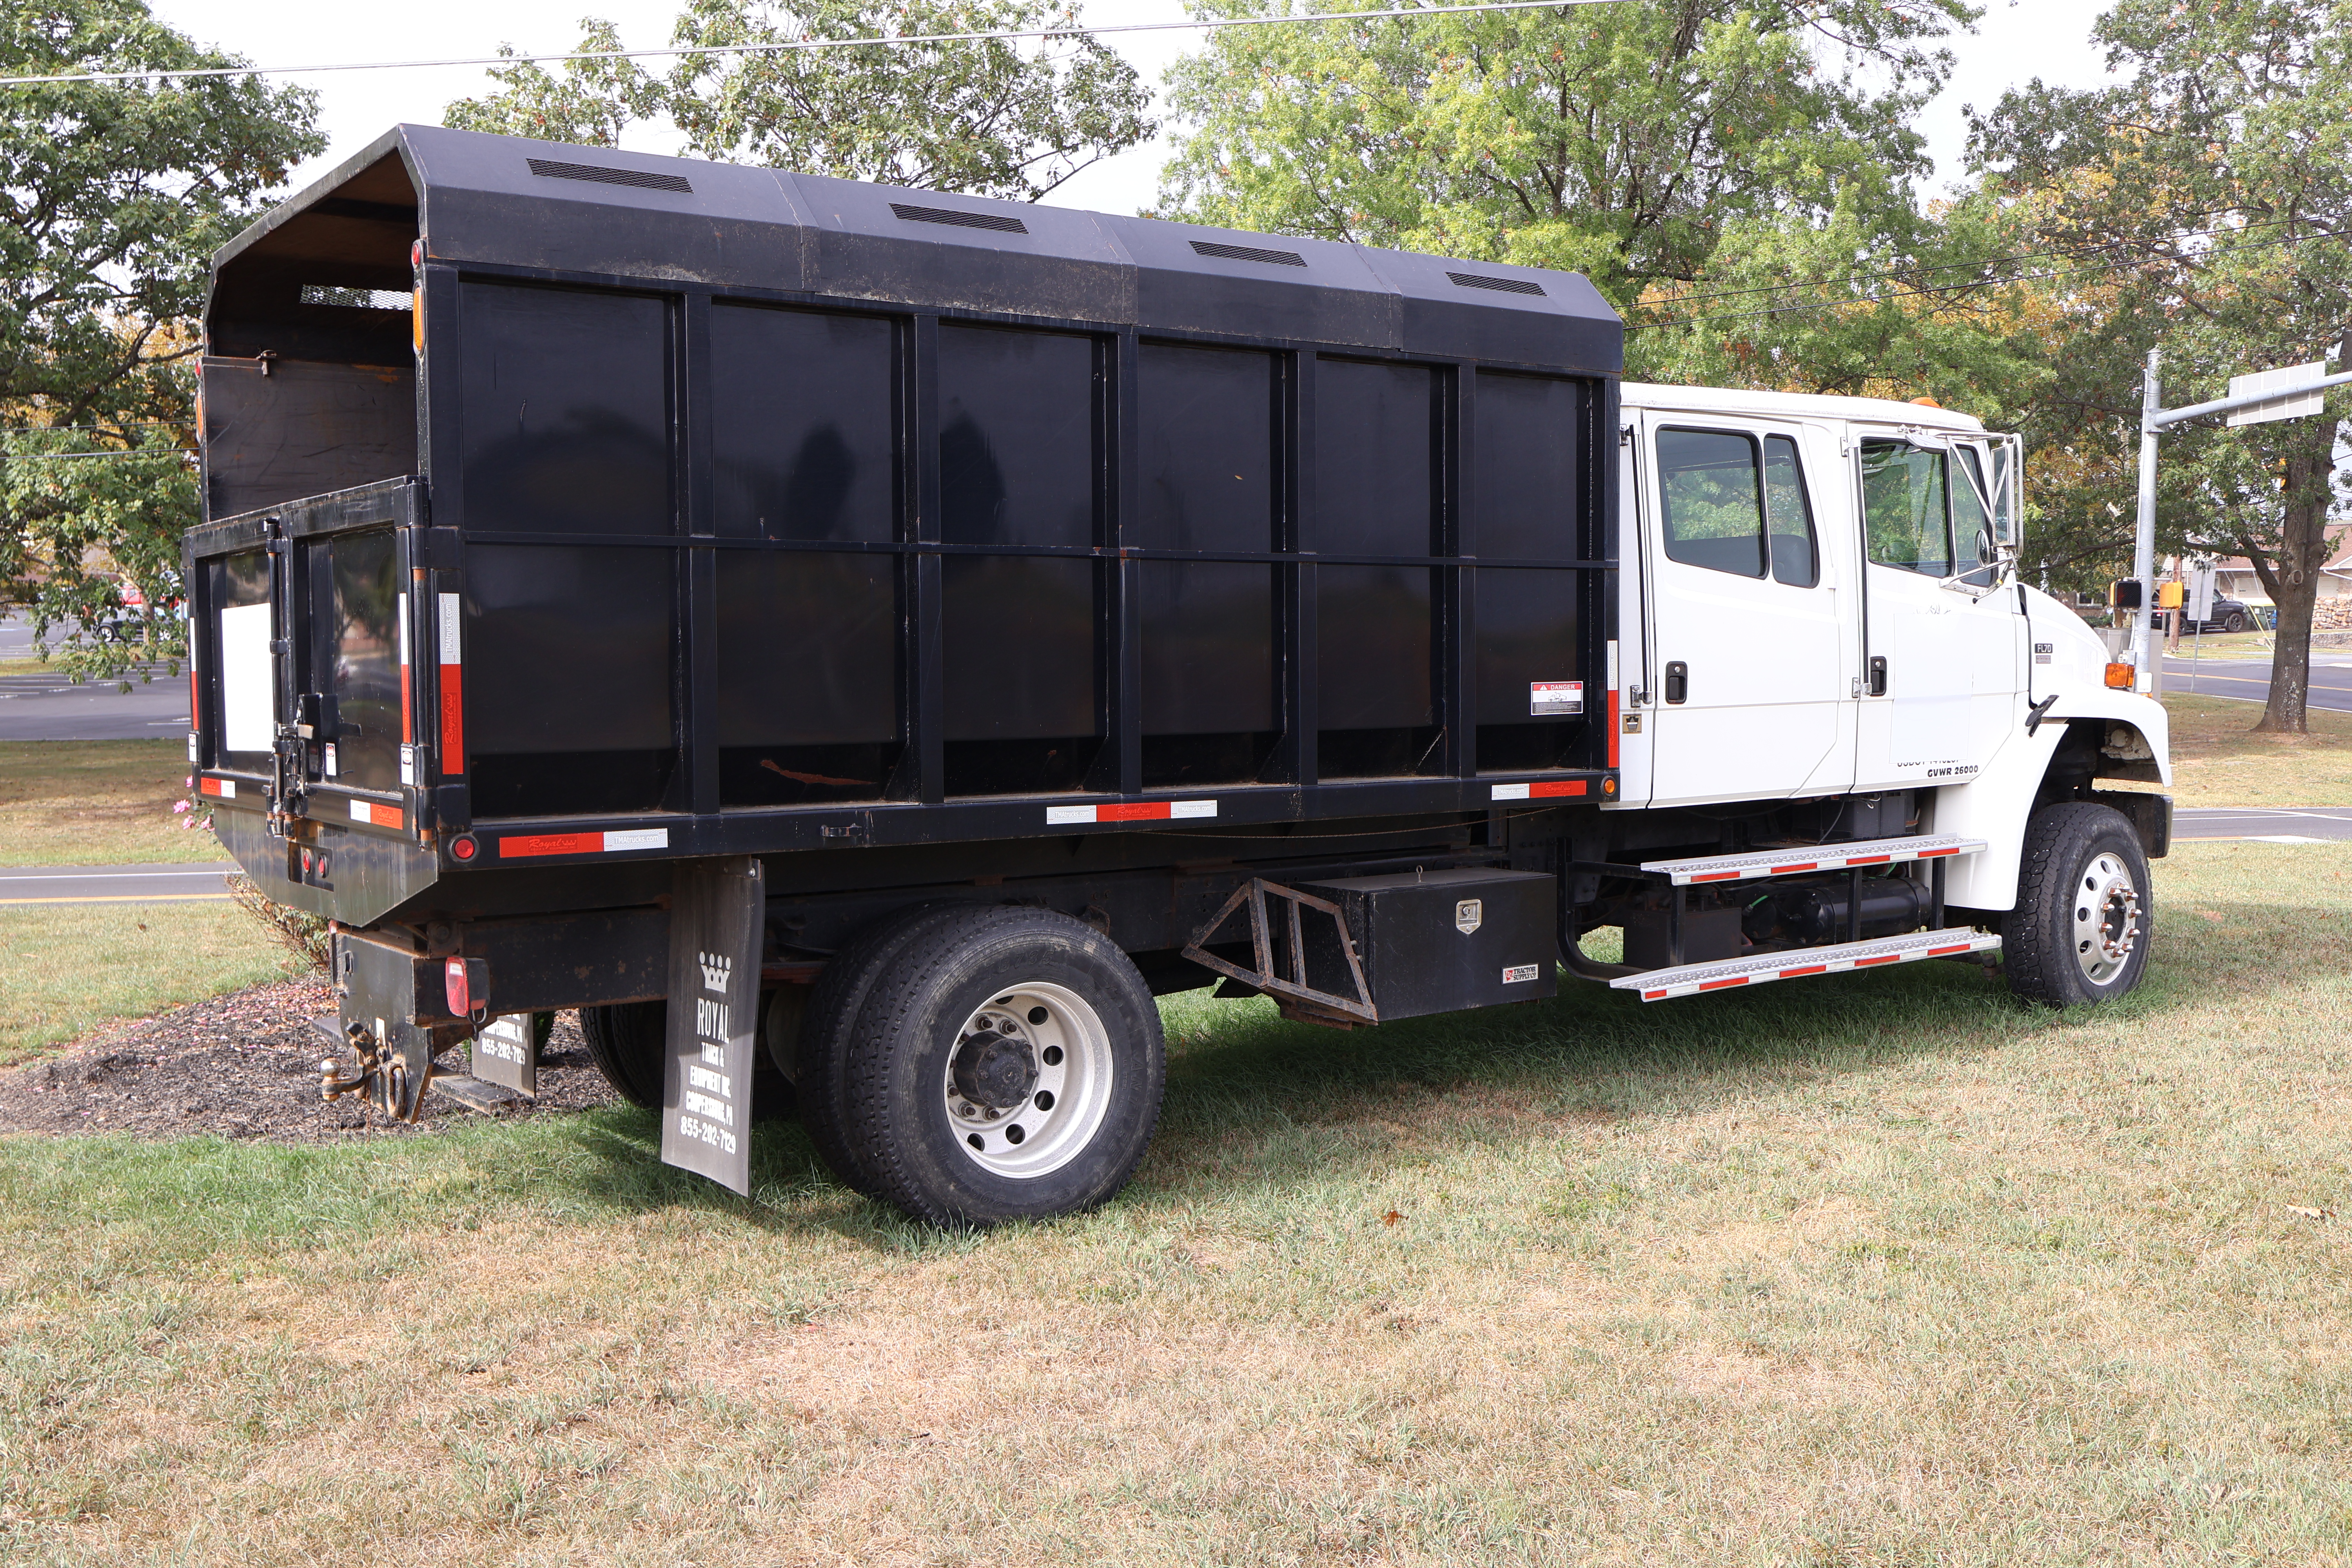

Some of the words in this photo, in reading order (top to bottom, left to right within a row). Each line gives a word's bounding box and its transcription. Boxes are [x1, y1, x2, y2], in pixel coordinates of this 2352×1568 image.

[445, 604, 453, 653] TMAtrucks.com
[2037, 644, 2051, 653] FL70
[444, 710, 455, 744] Royal
[1927, 768, 1952, 777] GVWR
[1955, 765, 1978, 775] 26000
[1117, 806, 1141, 815] Royal
[529, 838, 562, 849] Royal
[614, 835, 659, 844] TMAtrucks.com
[1514, 966, 1536, 975] TRACTOR
[697, 997, 729, 1044] ROYAL
[517, 1025, 523, 1043] PA
[481, 1037, 526, 1065] 855-202-7129
[701, 1042, 719, 1066] TRUCK
[720, 1048, 724, 1067] &
[690, 1065, 721, 1094] EQUIPMENT
[686, 1090, 726, 1126] COOPERSBURG,
[726, 1104, 733, 1127] PA
[680, 1115, 737, 1155] 855-202-7129
